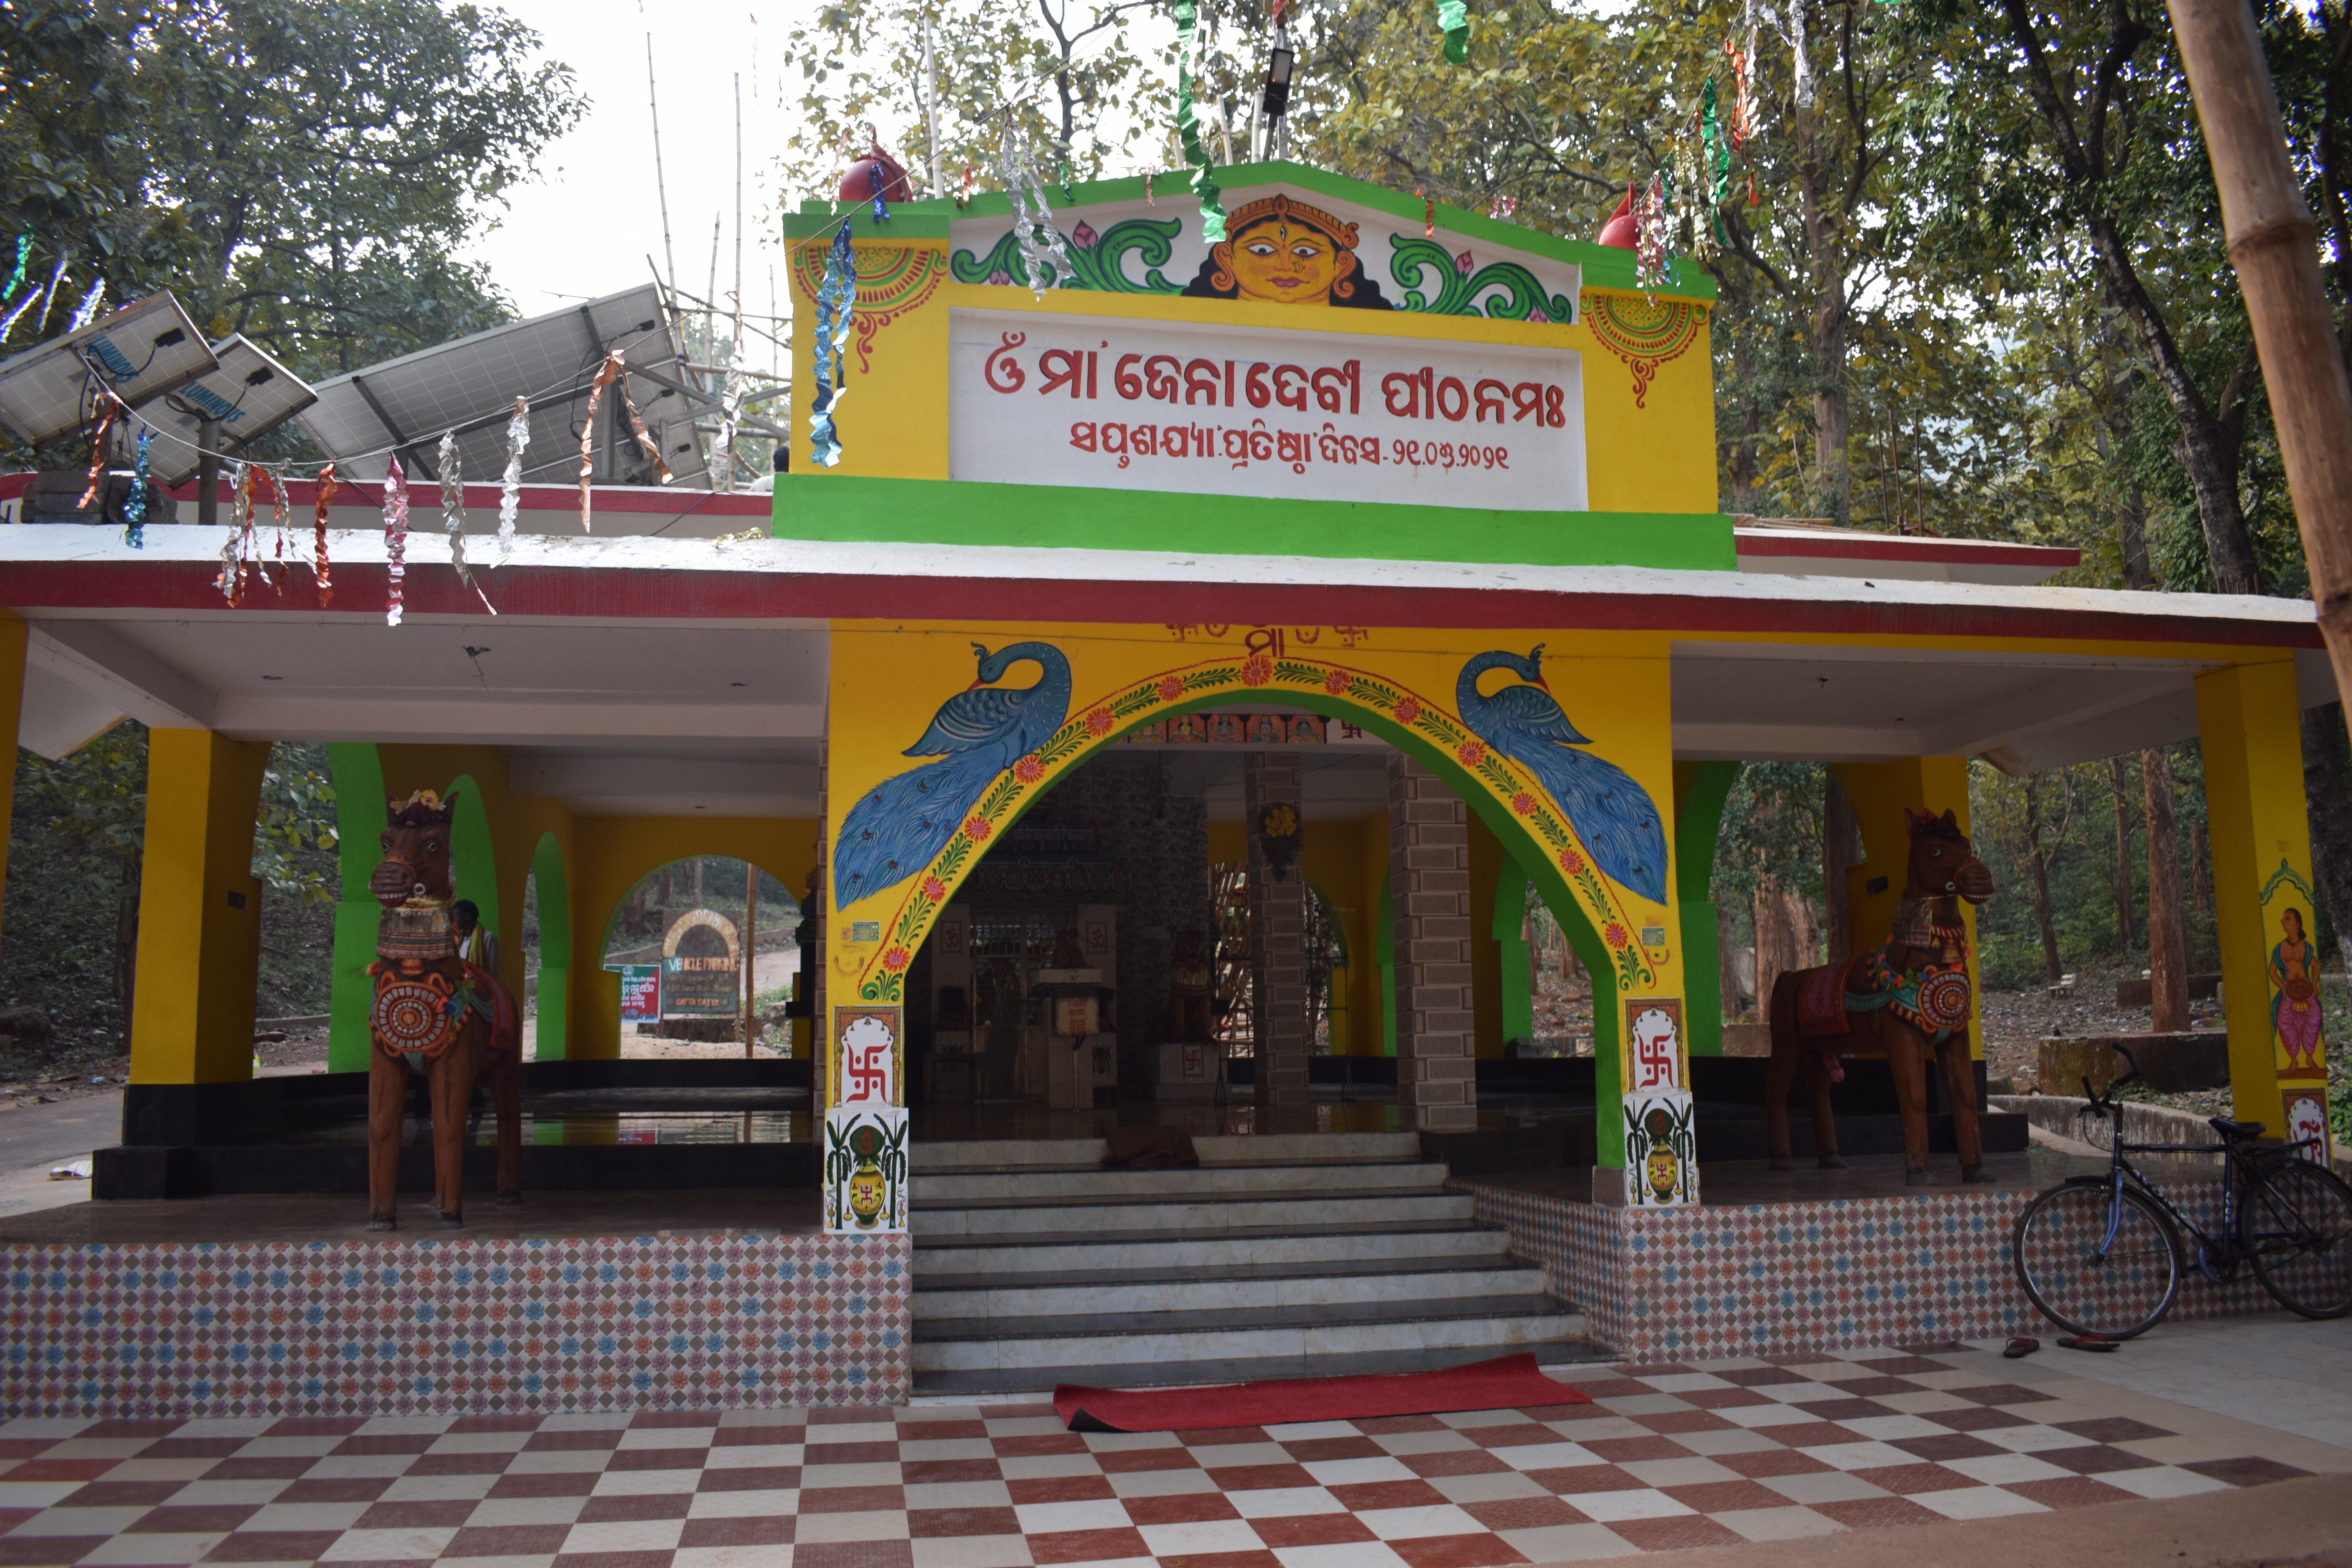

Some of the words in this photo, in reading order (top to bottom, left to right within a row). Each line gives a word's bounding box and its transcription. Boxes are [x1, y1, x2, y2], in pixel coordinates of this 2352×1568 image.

[1114, 353, 1235, 407] ଜେନା
[1245, 359, 1361, 415] ଦେବୀ
[668, 957, 702, 971] VEHICLE
